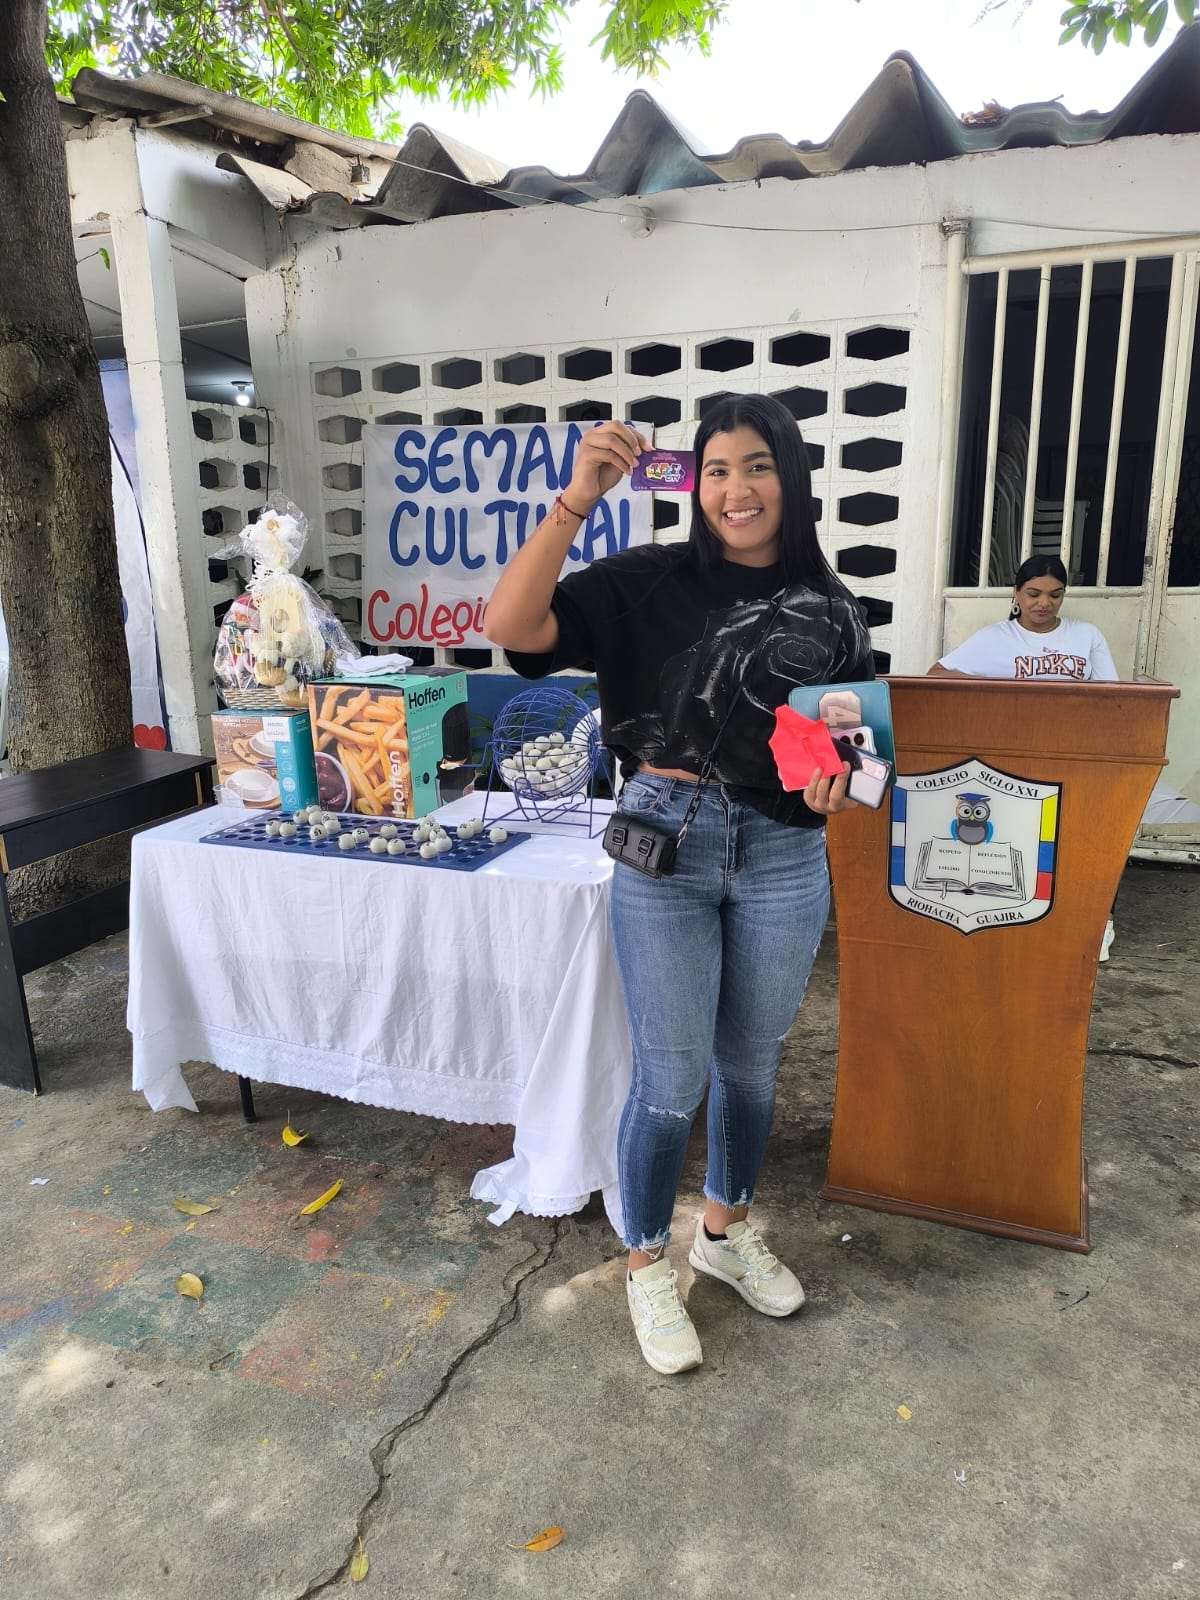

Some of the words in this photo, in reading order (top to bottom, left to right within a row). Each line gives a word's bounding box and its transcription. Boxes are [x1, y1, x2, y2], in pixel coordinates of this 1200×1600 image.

[394, 421, 635, 494] SEMA
[388, 497, 631, 570] CULTUAL
[367, 583, 488, 647] Colegi
[1014, 653, 1087, 680] NIKE
[408, 686, 446, 710] Hoffen
[389, 751, 406, 815] Hoffen
[915, 770, 969, 789] COLEGIO
[978, 770, 1014, 792] SIGLO
[1015, 786, 1040, 798] XXI
[907, 897, 961, 925] RIOHACHA
[976, 911, 1025, 925] GUAJIRA
